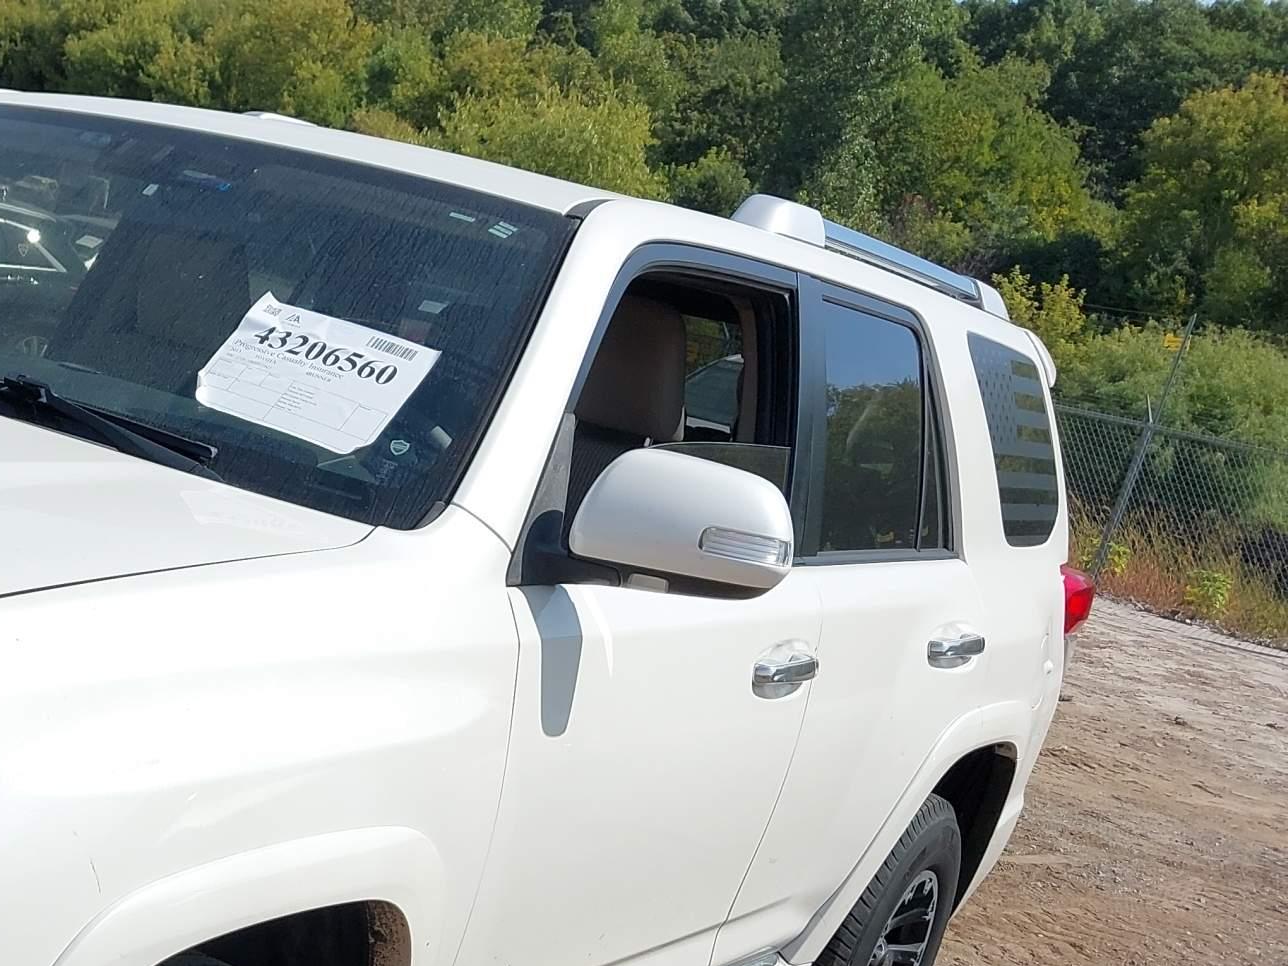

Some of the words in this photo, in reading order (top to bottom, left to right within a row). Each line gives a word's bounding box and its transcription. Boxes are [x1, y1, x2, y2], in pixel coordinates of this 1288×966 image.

[233, 339, 276, 357] Progressive
[276, 352, 306, 368] Casualty
[308, 362, 344, 380] Insurance
[253, 326, 398, 385] 43206560
